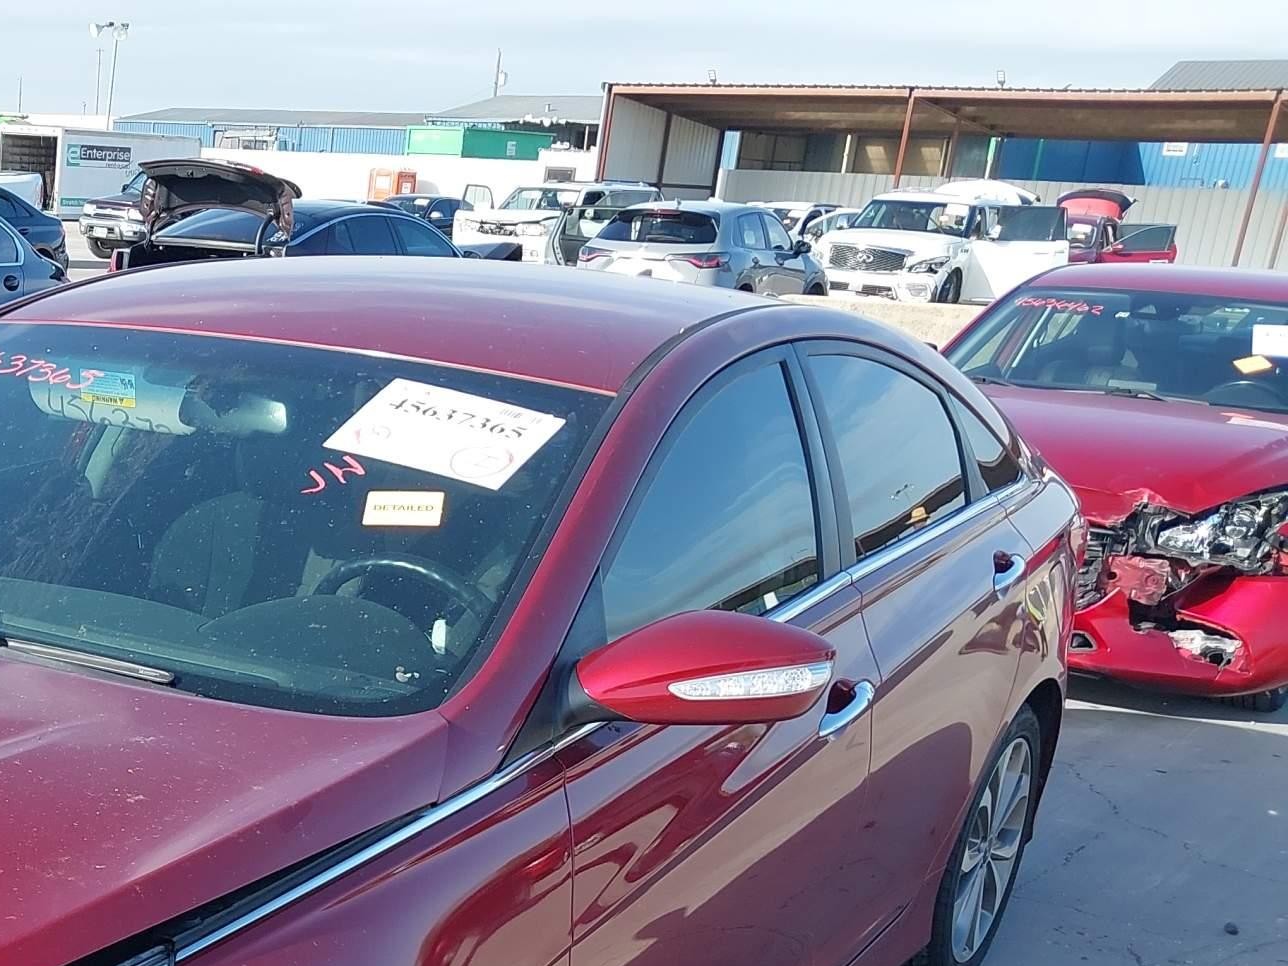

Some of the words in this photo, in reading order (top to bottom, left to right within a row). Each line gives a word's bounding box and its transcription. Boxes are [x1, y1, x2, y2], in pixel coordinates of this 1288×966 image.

[81, 146, 131, 162] Enterprise
[389, 398, 528, 440] 45637365
[372, 503, 435, 512] DETAILED
